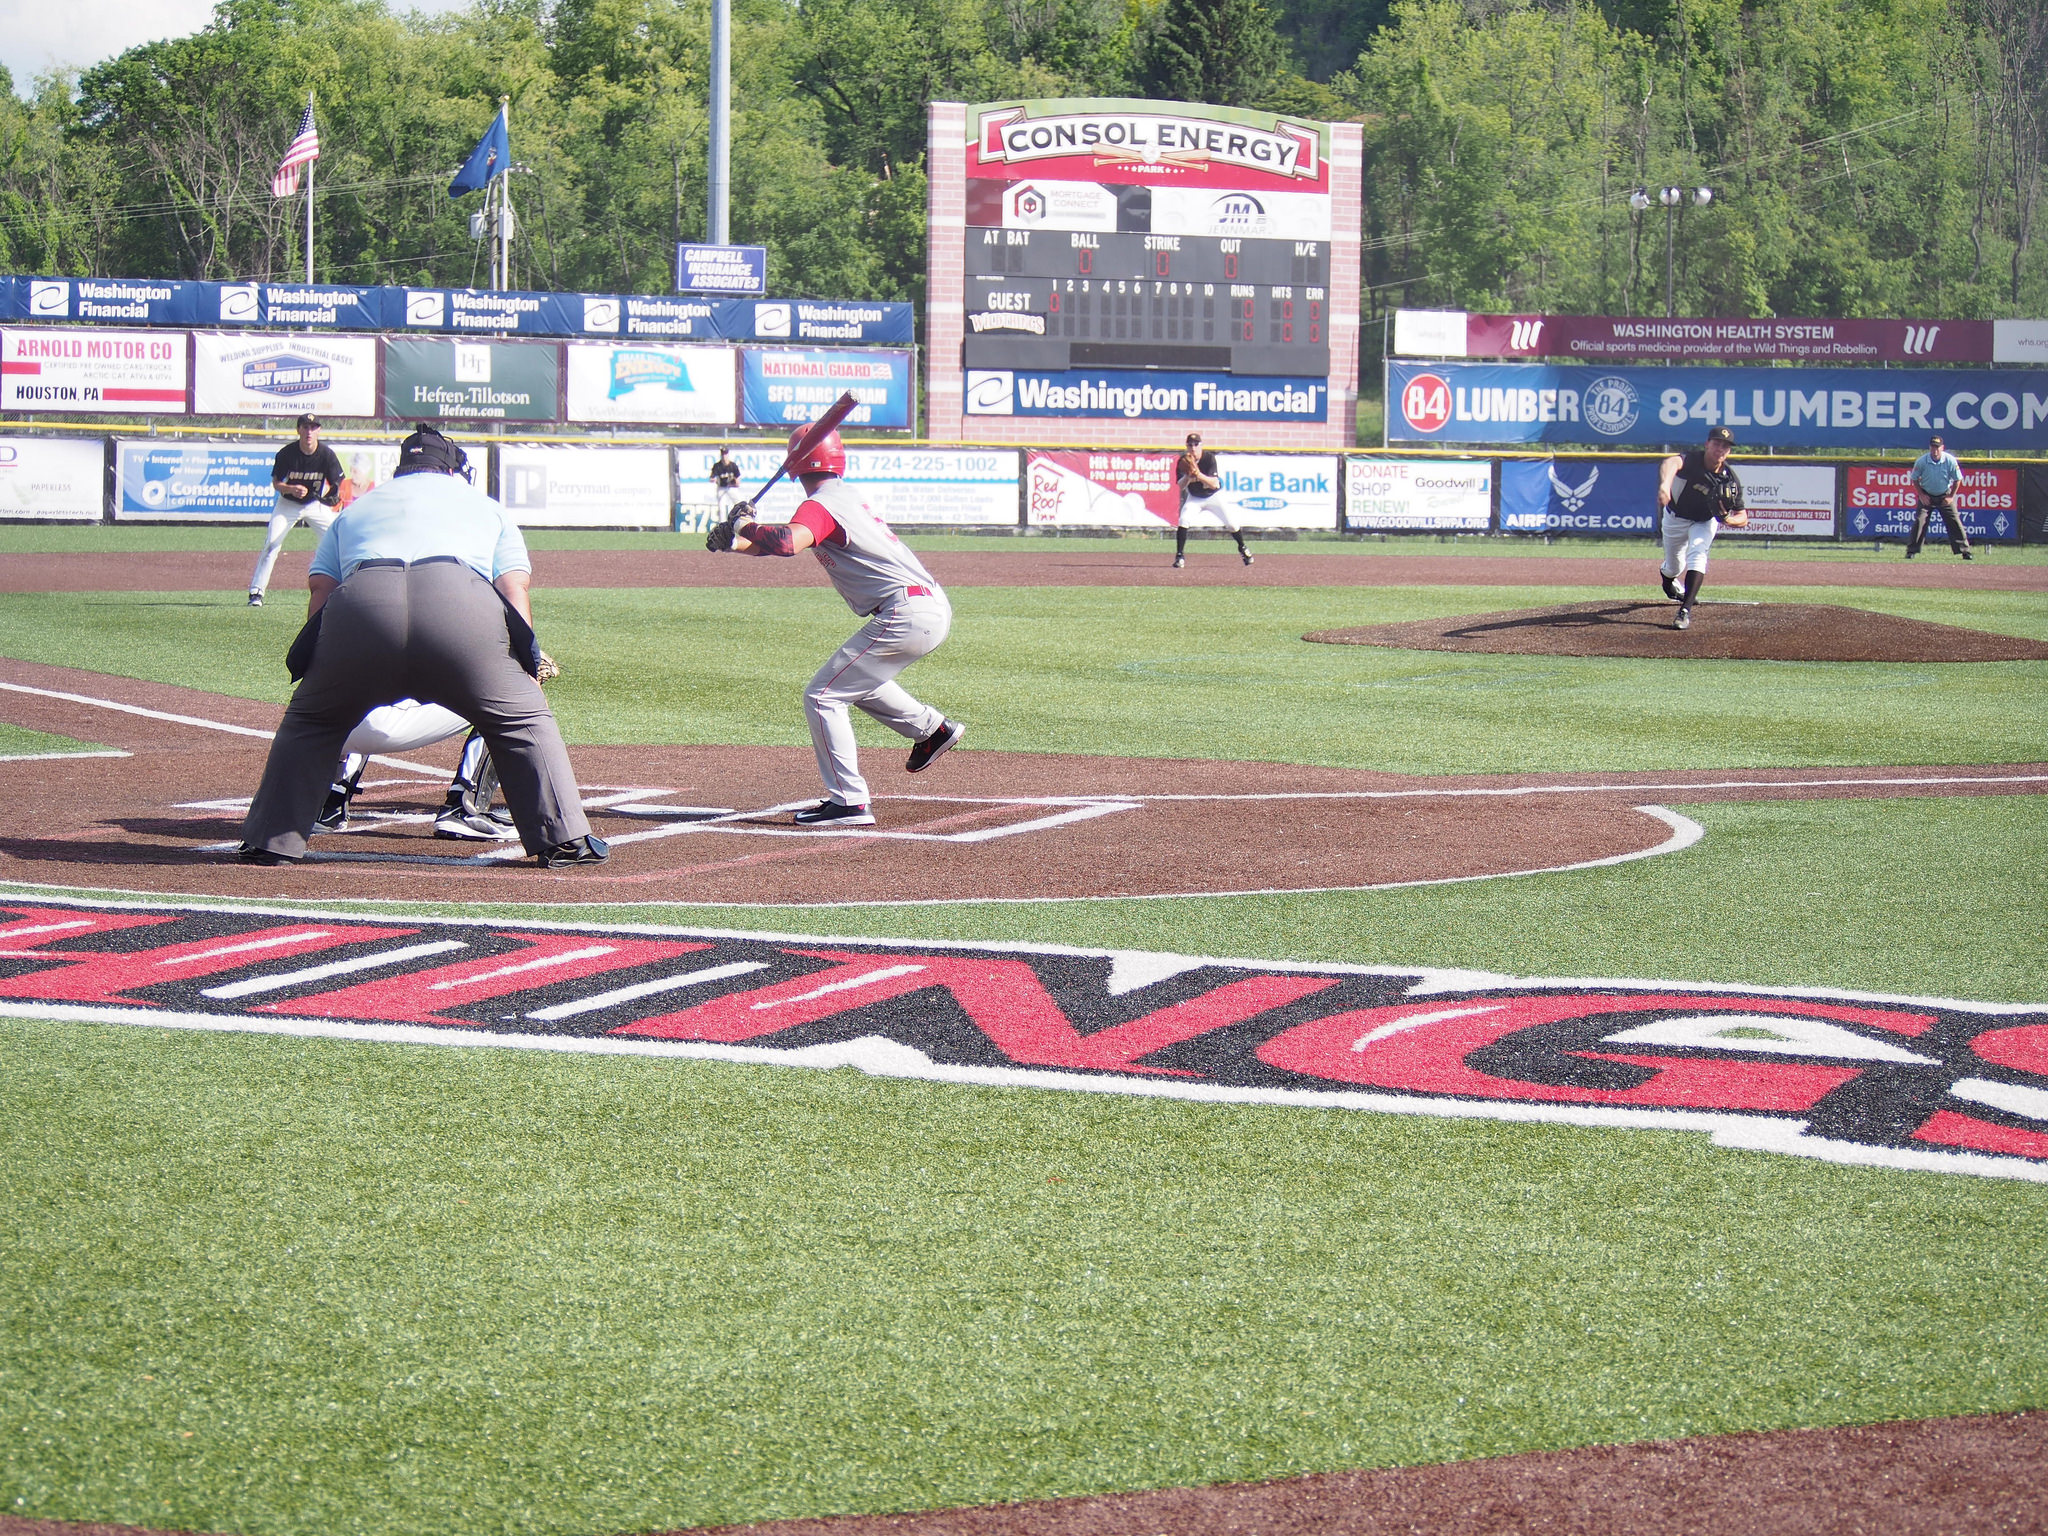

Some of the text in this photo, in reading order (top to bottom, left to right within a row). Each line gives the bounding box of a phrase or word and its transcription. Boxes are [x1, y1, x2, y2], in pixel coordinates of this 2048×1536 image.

[1008, 123, 1294, 166] CONSOL ENERGY
[1137, 164, 1165, 173] PARK
[1051, 190, 1104, 199] MORTGAGE
[1054, 199, 1099, 208] CONNECT
[1208, 225, 1267, 235] JENNMAR
[984, 230, 1317, 257] AT BAT BALL STRIKE OUT H/E
[684, 249, 744, 263] CAMPBELL
[1079, 249, 1092, 274] 0
[1156, 251, 1169, 276] 0
[687, 262, 753, 276] INSURANCE
[1225, 254, 1237, 278] 0
[690, 274, 760, 290] ASSOCIATES
[1052, 279, 1324, 300] 1 2 3 4 5 6 7 8 9 10 RUNS HITS ERR
[78, 283, 172, 303] Washington
[267, 288, 358, 308] Washington
[988, 293, 1031, 310] GUEST
[79, 301, 149, 318] Financial
[451, 293, 540, 314] Washington
[627, 300, 711, 319] Washington
[1050, 293, 1059, 312] 0
[1244, 300, 1319, 320] 0 0 0
[267, 306, 336, 323] Financial
[452, 311, 519, 328] Financial
[798, 305, 882, 325] Washington
[628, 318, 692, 334] Financial
[799, 323, 863, 338] Financial
[1243, 322, 1319, 343] 0 0 0
[1612, 324, 1834, 340] WASHINGTON HEALTH SYSTEM
[17, 339, 172, 360] ARNOLD MOTOR CO
[219, 342, 354, 366] WELDING SUPPLIES INDUSTRIAL GASES
[1570, 340, 1877, 356] Official sports medicine provider of the Wild Things and Rebellion
[244, 371, 273, 387] WEST
[274, 369, 302, 385] PENN
[303, 367, 330, 382] LACO
[763, 362, 870, 377] NATIONAL GUARD
[16, 385, 99, 402] HOUSTON, PA
[413, 385, 531, 405] Hefren-Tillotson
[768, 385, 833, 403] SFC MARC
[1018, 379, 1316, 417] Washington Financial
[438, 404, 505, 417] Hefren.com
[1408, 386, 1579, 422] 84 LUMBER
[1598, 394, 1625, 417] 84
[1659, 389, 2048, 430] 84LUMBER.COM
[133, 455, 264, 465] TV Internet Phone The Phone
[703, 455, 782, 471] DAN'S
[870, 456, 997, 471] 724-225-1002
[1089, 456, 1170, 471] Hit the Roof!
[209, 466, 223, 475] and
[225, 466, 248, 475] Office
[1352, 464, 1409, 479] DONATE
[549, 480, 610, 496] Perryman
[1033, 475, 1058, 493] Red
[1270, 472, 1329, 493] Bank
[1415, 477, 1475, 488] Goodwill
[1962, 472, 1997, 487] with
[171, 480, 275, 497] Consolidated
[1352, 482, 1391, 496] SHOP
[1747, 486, 1779, 497] SUPPLY
[171, 496, 274, 507] communications
[1032, 491, 1065, 513] Roof
[1352, 499, 1410, 513] RENEW!
[1852, 488, 1917, 507] Sarris
[1348, 516, 1489, 528] WWW.GOODWILLSWPA.ORG
[1506, 514, 1653, 529] AIRFORCE.COM
[1814, 511, 1830, 520] 1921
